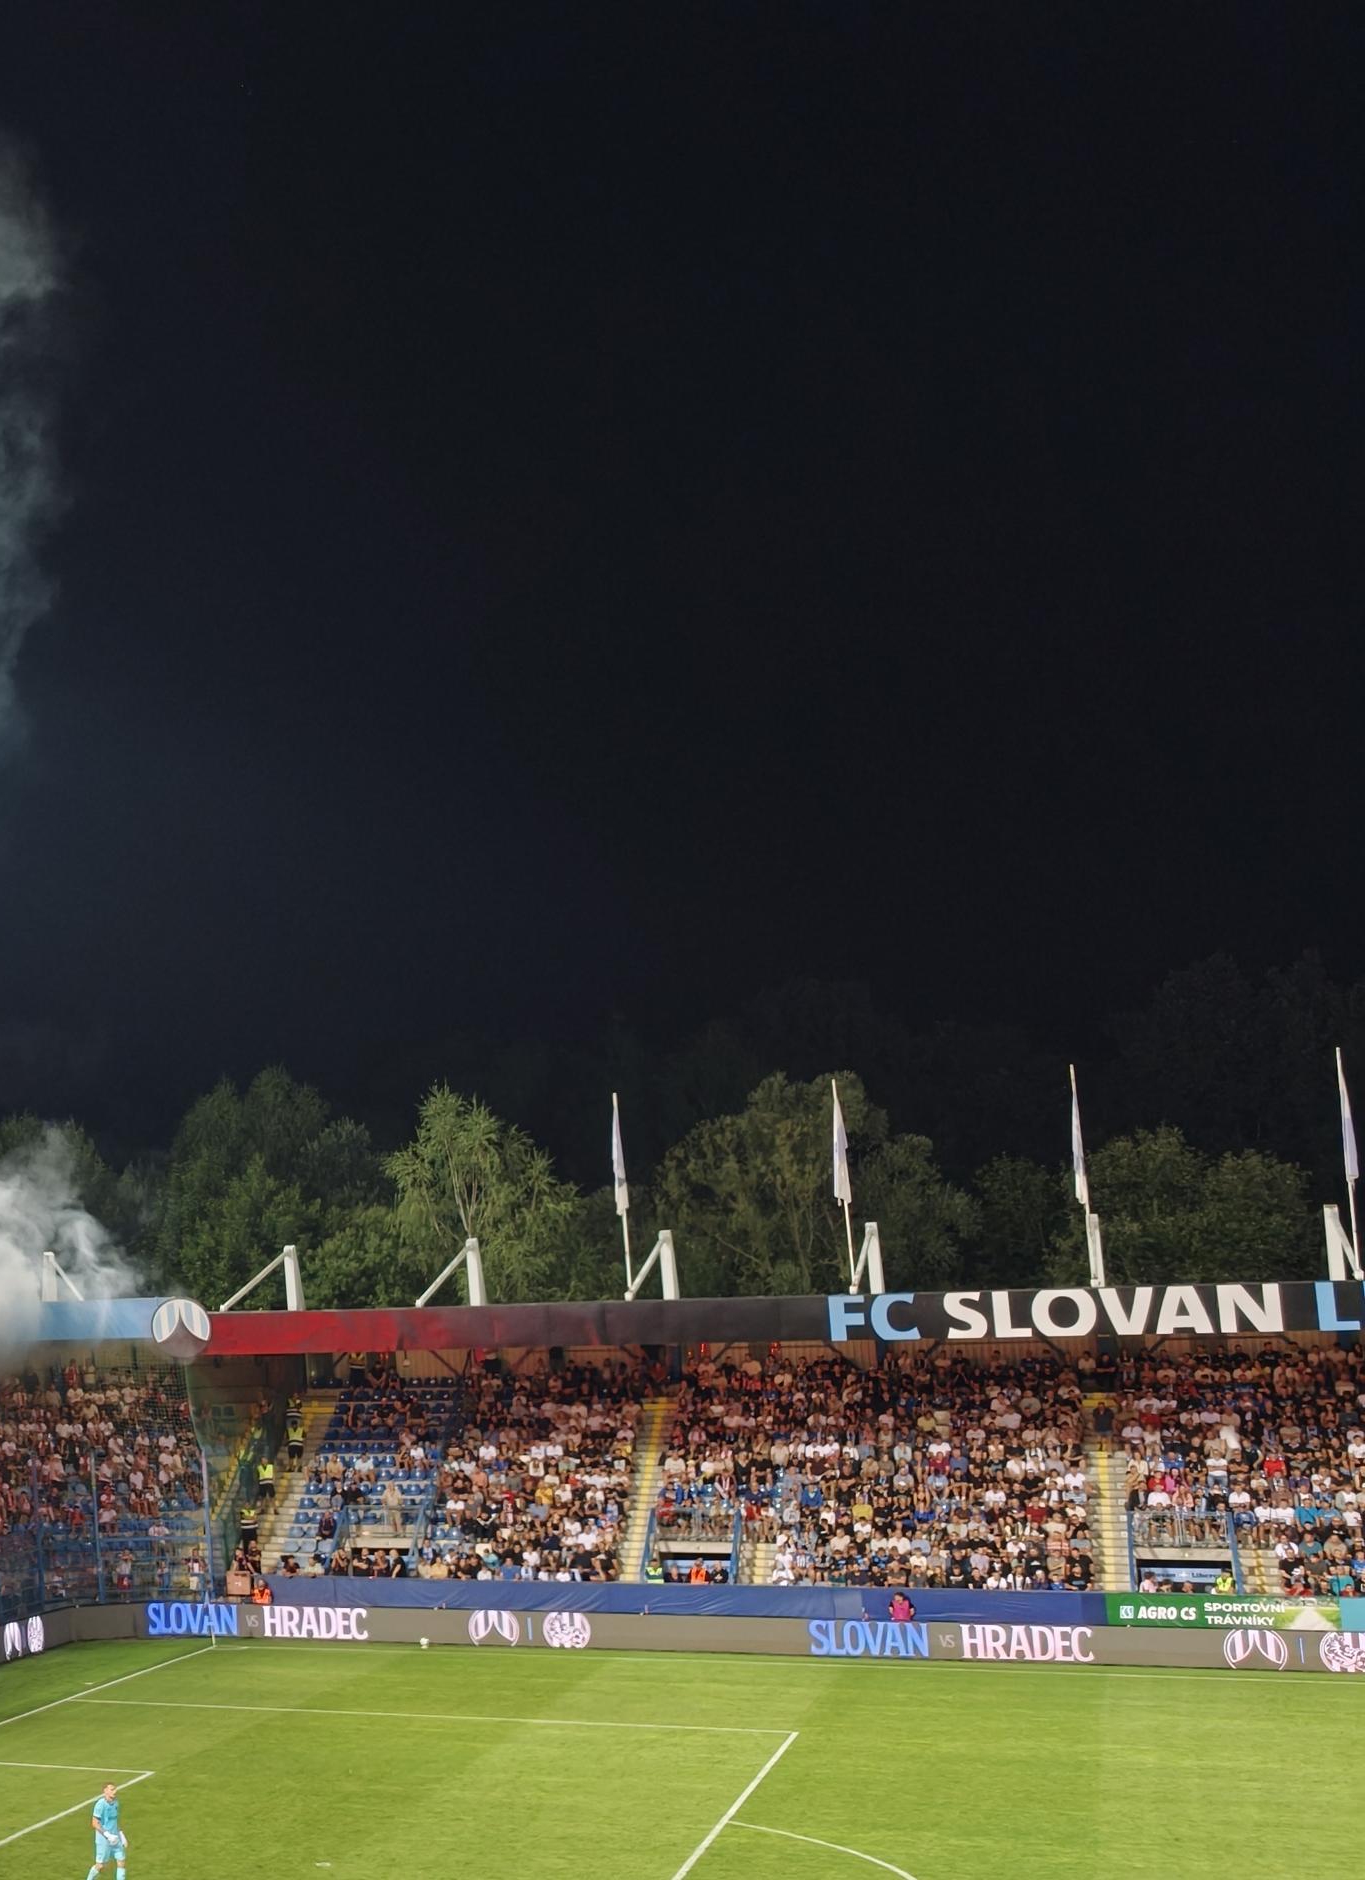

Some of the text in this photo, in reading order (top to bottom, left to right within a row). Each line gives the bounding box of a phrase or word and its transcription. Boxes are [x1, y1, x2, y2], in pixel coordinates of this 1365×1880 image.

[828, 1281, 1365, 1341] FC SLOVAN L
[1137, 1606, 1197, 1621] AGRO CS
[1204, 1600, 1286, 1614] SPORTOVNÍ
[1205, 1613, 1276, 1626] TRÁVNÍKY
[147, 1602, 238, 1636] SLOVAN
[263, 1605, 368, 1640] HRADEC
[808, 1620, 930, 1657] SLOVAN
[959, 1624, 1095, 1662] HRADEC
